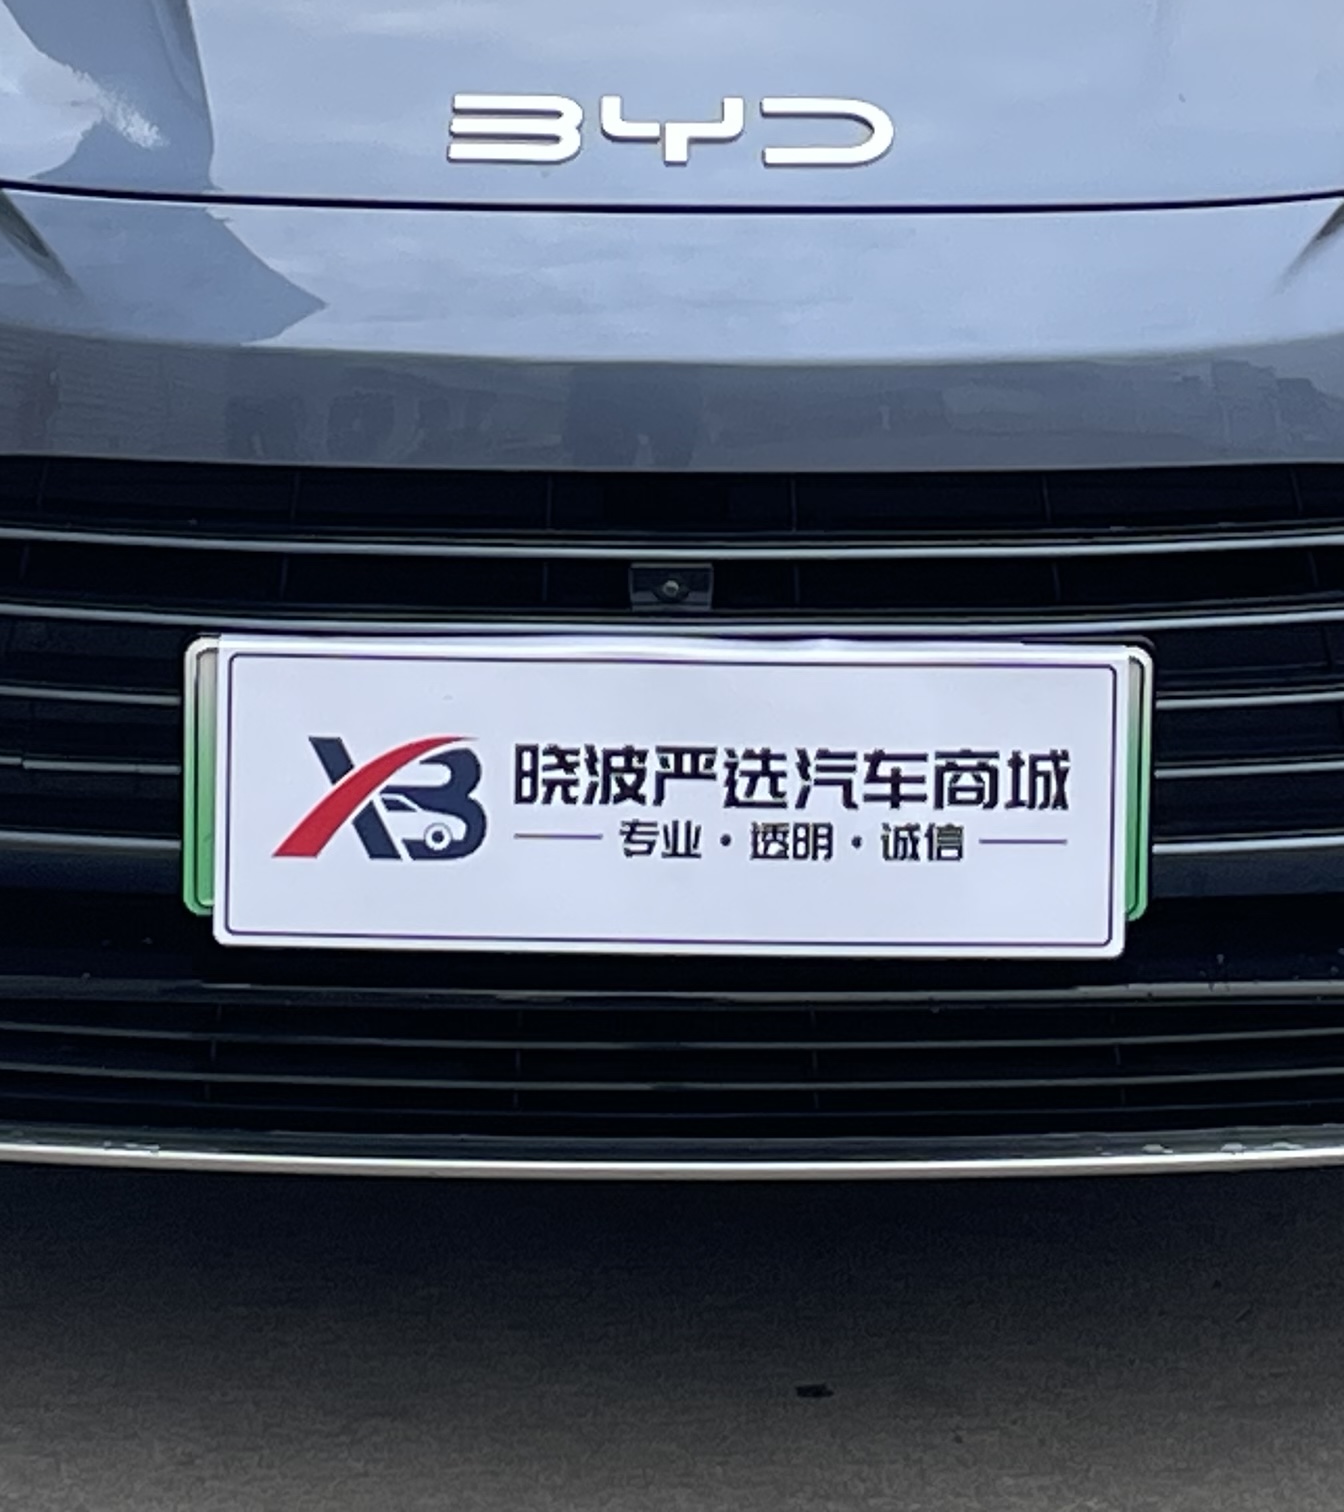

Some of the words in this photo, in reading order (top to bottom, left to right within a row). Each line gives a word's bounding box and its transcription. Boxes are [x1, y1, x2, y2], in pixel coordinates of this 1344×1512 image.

[447, 94, 895, 167] BYD
[513, 743, 1071, 811] 晓波严选汽车商城
